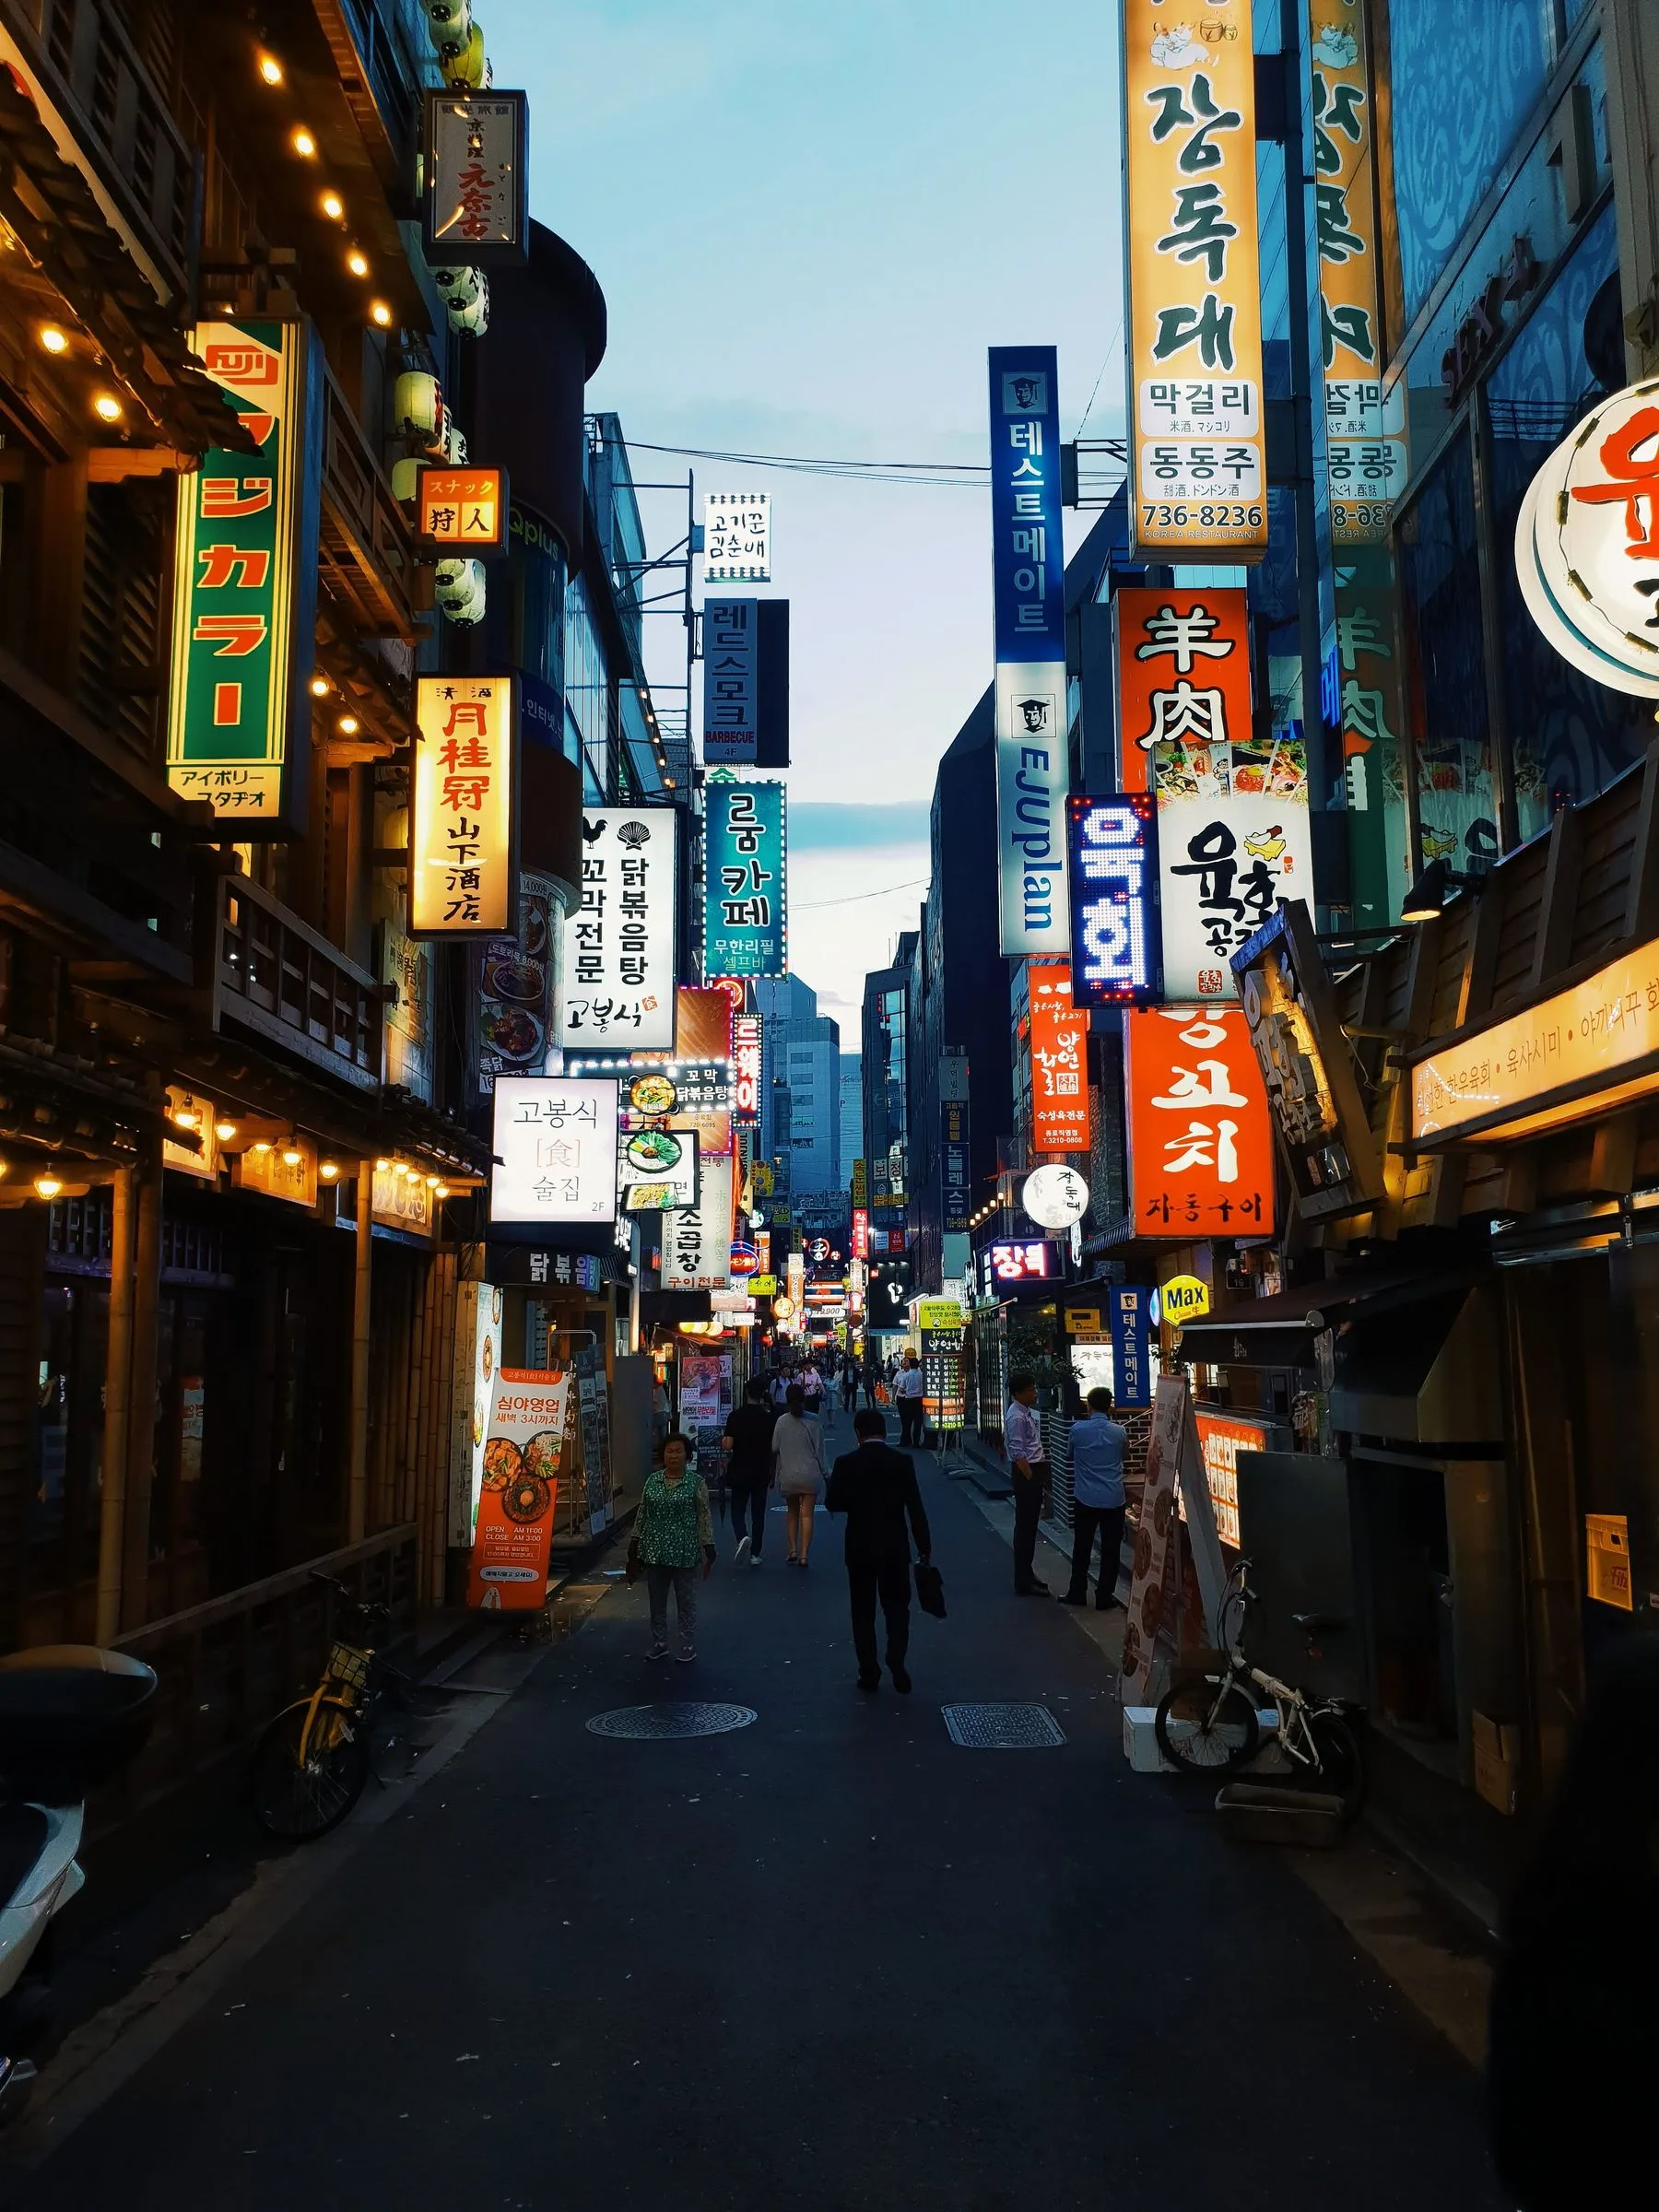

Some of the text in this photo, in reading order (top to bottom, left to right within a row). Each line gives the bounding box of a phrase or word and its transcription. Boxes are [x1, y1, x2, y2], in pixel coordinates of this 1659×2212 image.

[1147, 71, 1242, 372] 장독대
[1150, 383, 1250, 415] 막걸리
[1150, 447, 1254, 479] 동동주
[430, 479, 494, 495] スナック
[429, 508, 490, 532] 狩人
[1010, 421, 1049, 632] 테스트메이트
[1142, 505, 1263, 527] 736-8236
[1145, 530, 1258, 538] KOREA RESTAURANT
[712, 605, 749, 726] 레드스모크
[1135, 604, 1236, 751] 羊肉
[705, 731, 754, 744] BARBECUE
[724, 747, 737, 757] 4F
[437, 702, 492, 812] 月桂冠
[182, 771, 265, 786] アイボリー
[1012, 746, 1053, 932] EJUplan
[442, 817, 482, 922] 山下酒店
[1081, 808, 1146, 984] 육회
[575, 859, 607, 982] 꼬막전문
[619, 858, 650, 985] 닭볶음탕
[714, 939, 774, 955] 무한리필
[723, 956, 766, 971] 셀프바
[568, 998, 642, 1033] 고봉식
[1507, 1026, 1561, 1078] 육사시미
[686, 1068, 718, 1083] 꼬막
[677, 1085, 728, 1101] 닭볶음탕
[513, 1099, 597, 1130] 고봉식
[532, 1176, 581, 1202] 술집
[1057, 1171, 1080, 1211] 장독대
[592, 1202, 605, 1212] 2F
[1147, 1194, 1262, 1224] 자동구이
[668, 1277, 726, 1288] 구이전문
[1167, 1287, 1205, 1310] Max
[1123, 1313, 1139, 1398] 테스트메이트
[495, 1412, 559, 1425] 새벽 3시까지
[498, 1396, 559, 1413] 심야영업
